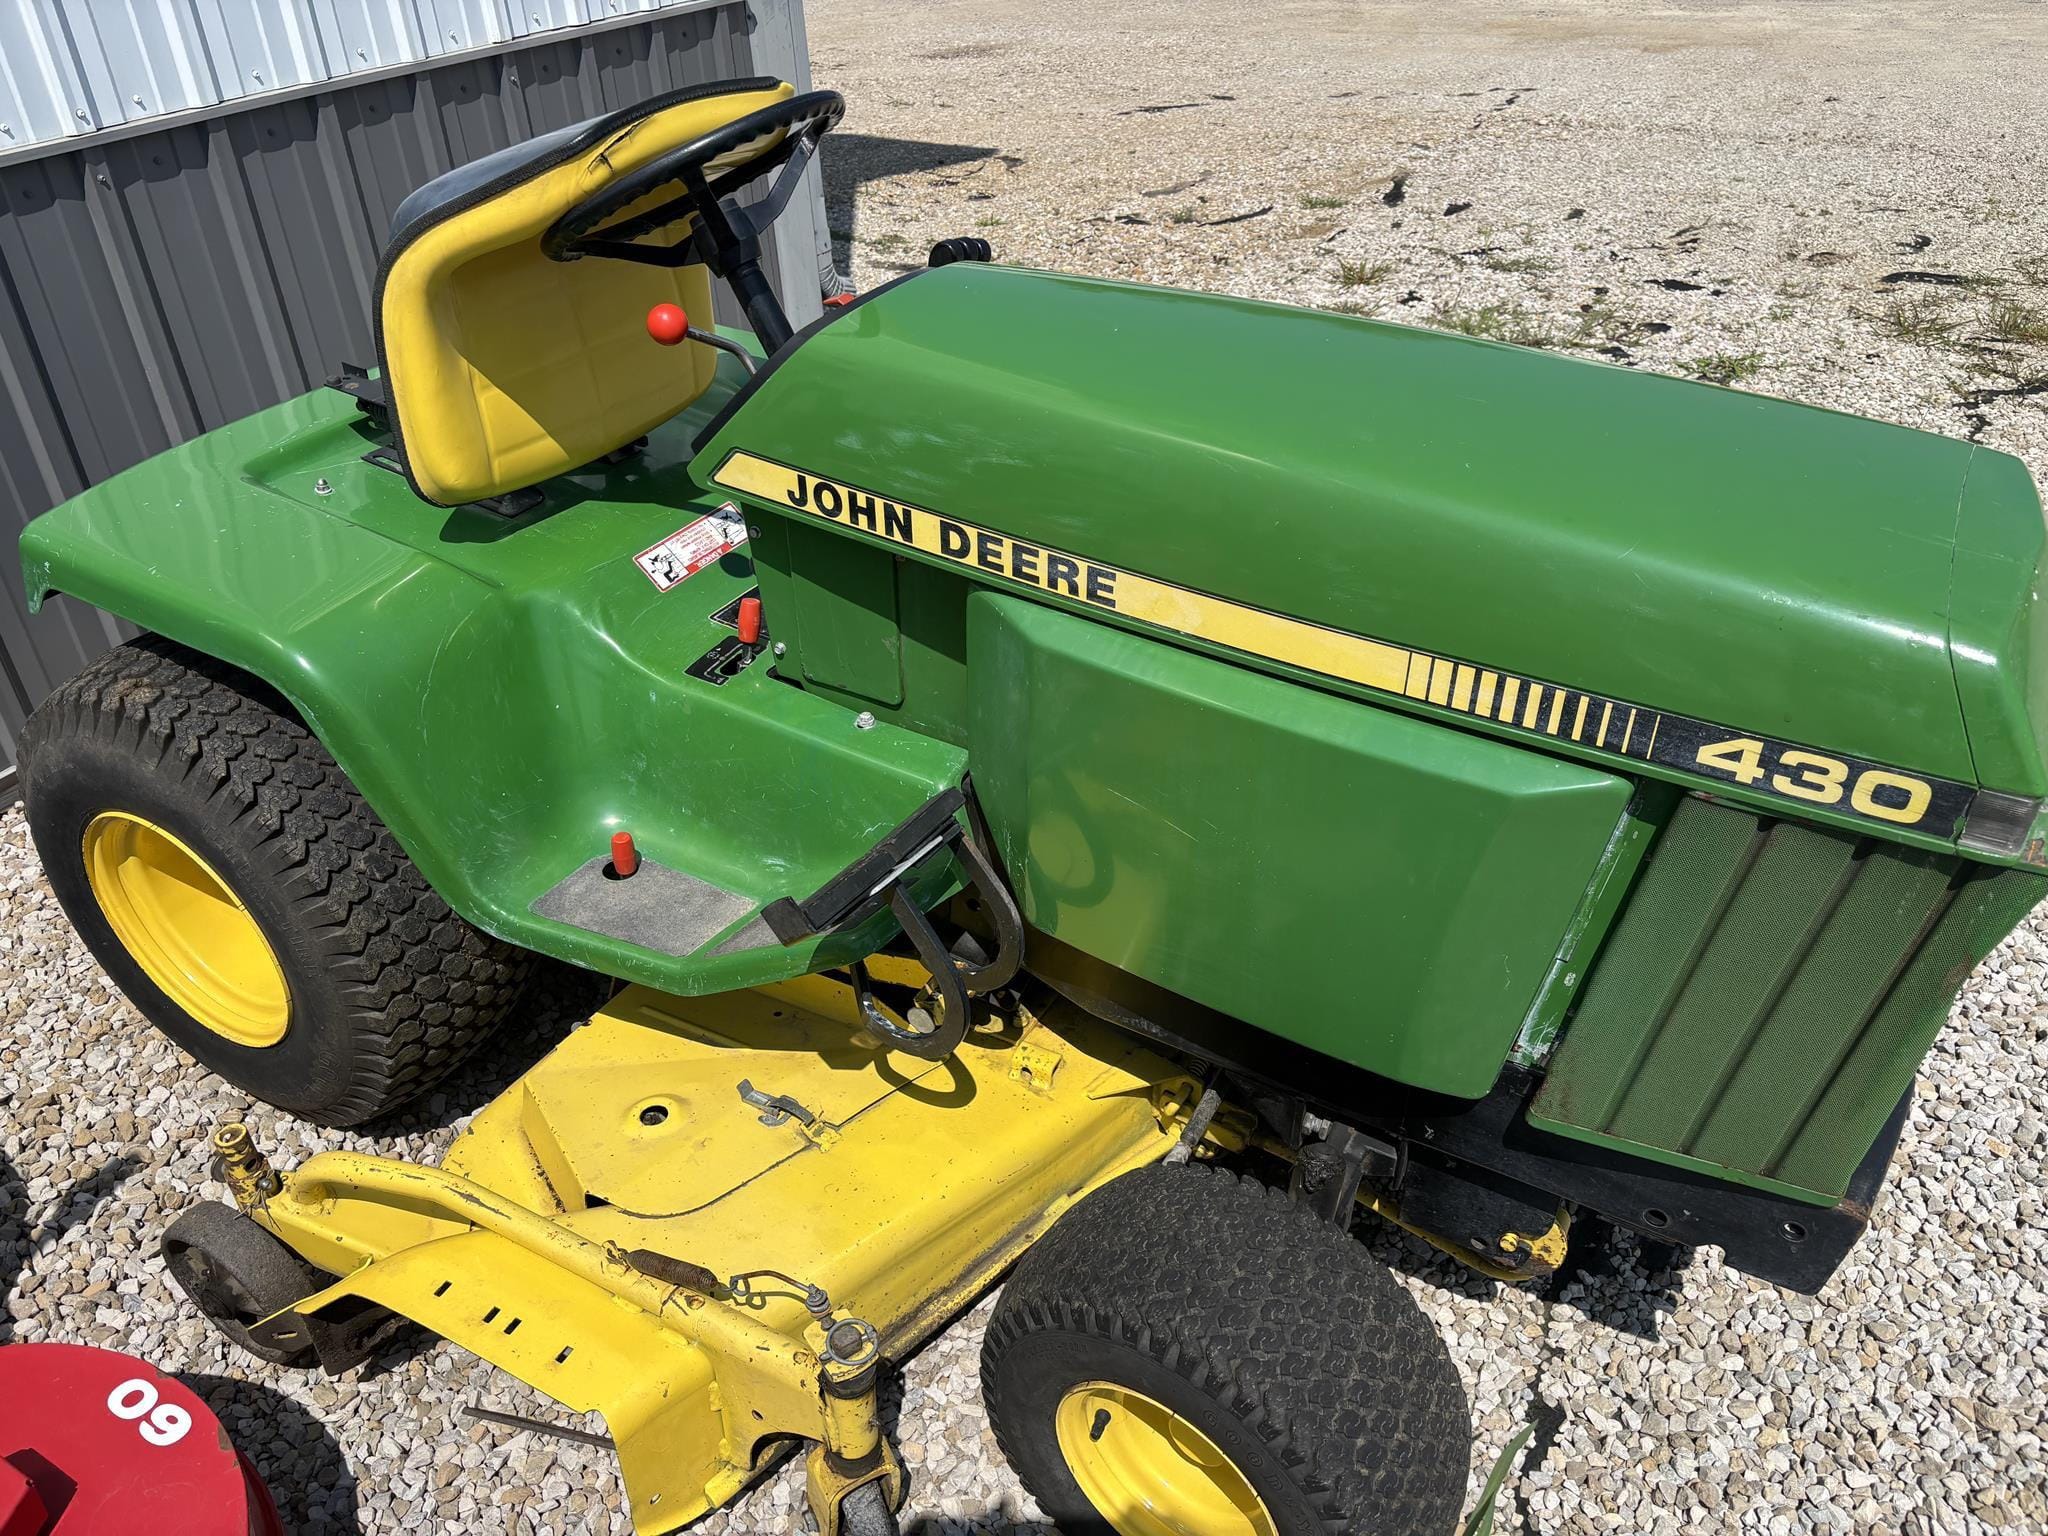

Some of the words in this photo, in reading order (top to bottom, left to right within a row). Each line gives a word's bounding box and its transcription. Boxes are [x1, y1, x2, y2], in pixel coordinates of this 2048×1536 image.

[787, 474, 913, 544] JOHN
[939, 519, 1117, 609] DEERE
[1696, 738, 1932, 824] 430
